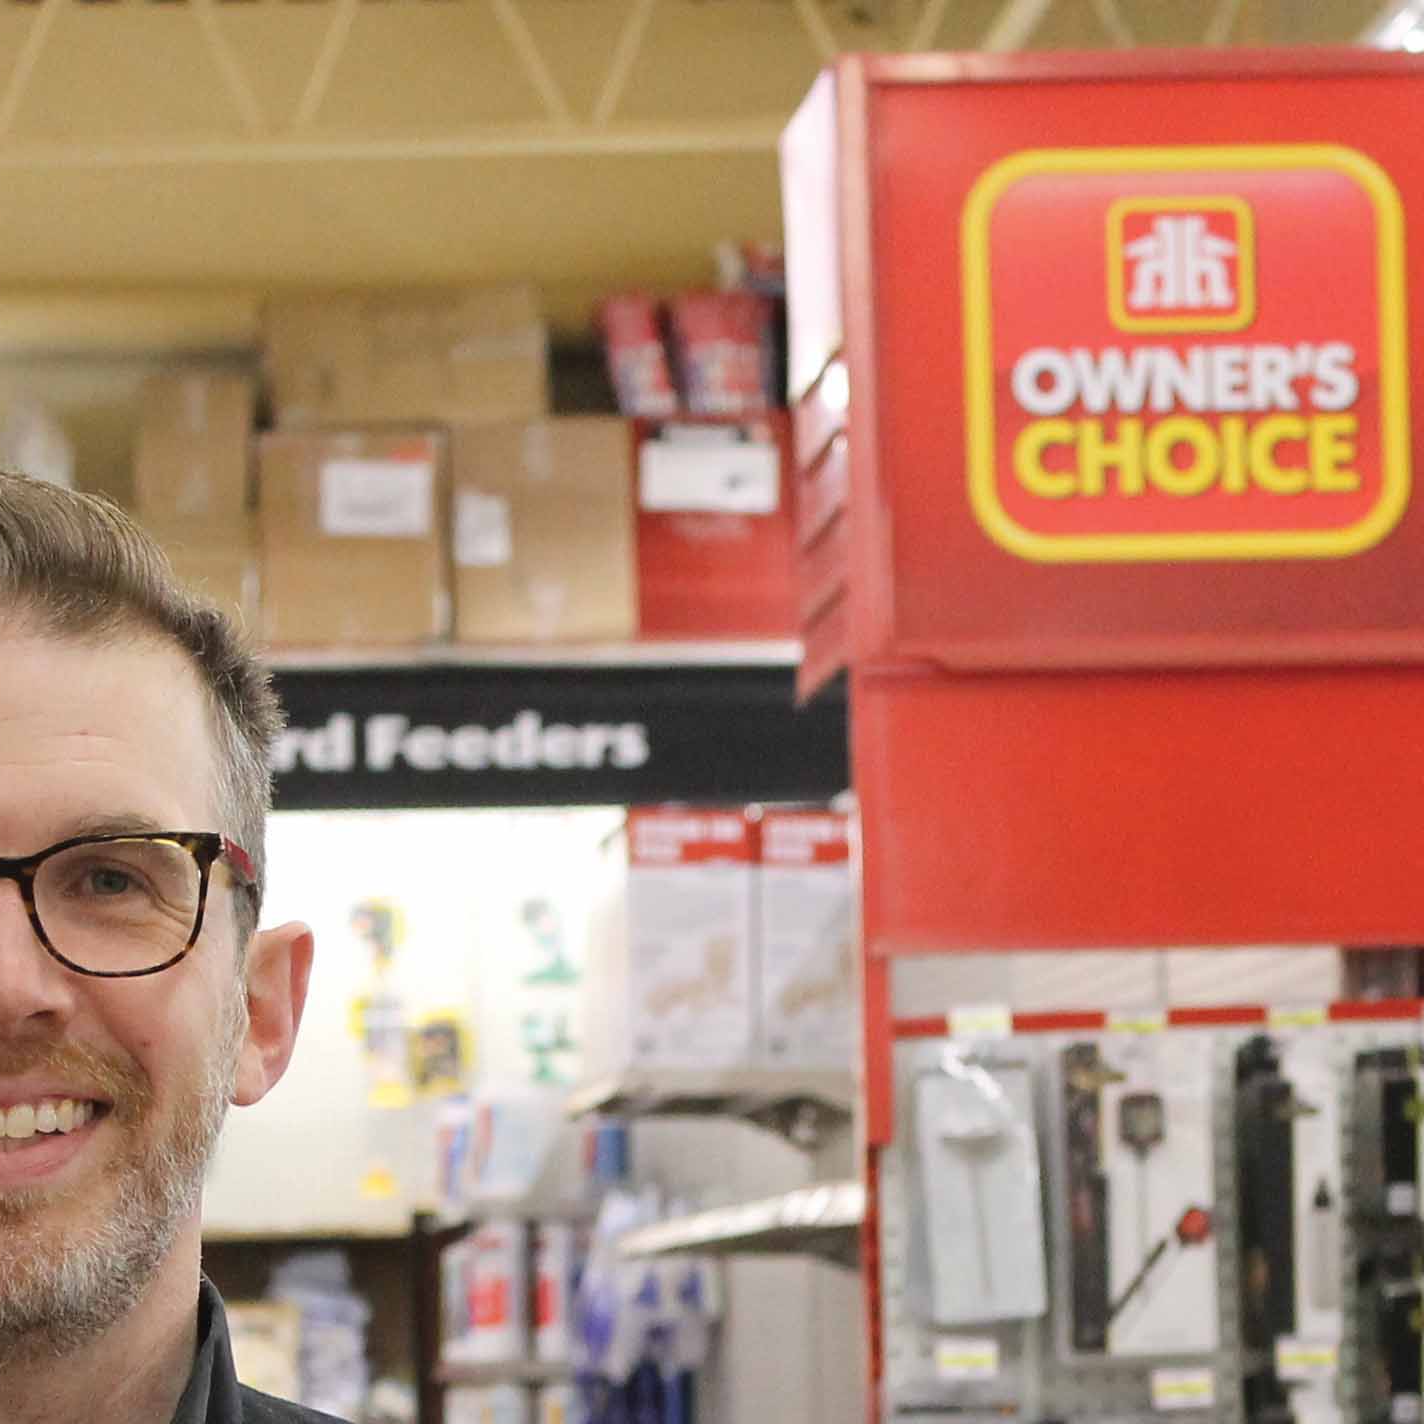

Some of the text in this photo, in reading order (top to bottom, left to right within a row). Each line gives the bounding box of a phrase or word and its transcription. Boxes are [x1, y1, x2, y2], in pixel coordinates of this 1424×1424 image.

[1012, 343, 1358, 414] OWNER'S
[1012, 414, 1359, 497] CHOICE
[364, 711, 649, 770] Feeders
